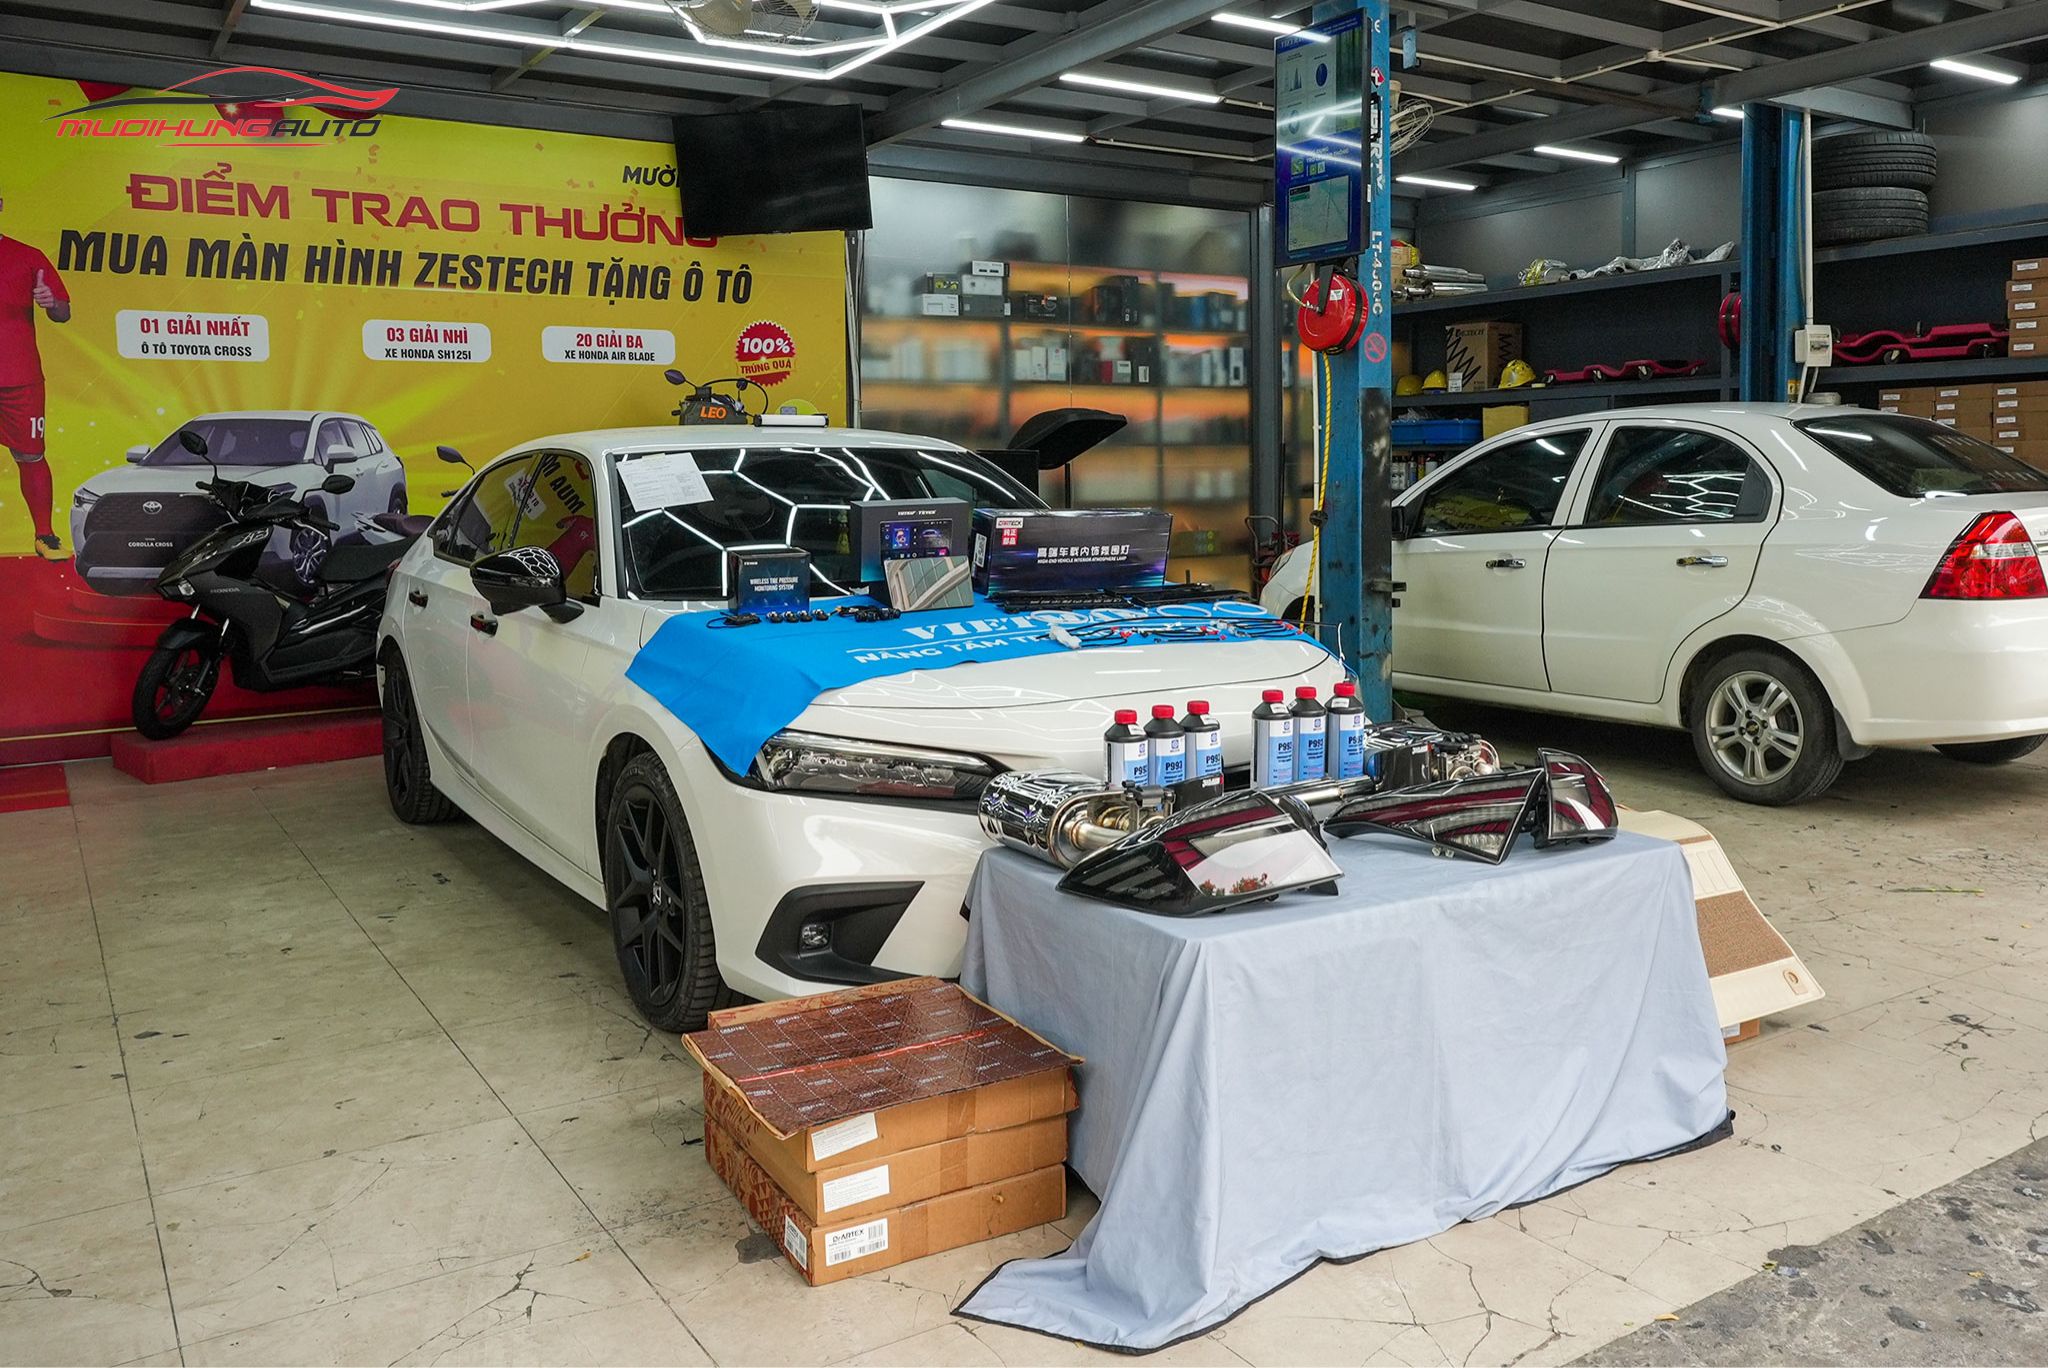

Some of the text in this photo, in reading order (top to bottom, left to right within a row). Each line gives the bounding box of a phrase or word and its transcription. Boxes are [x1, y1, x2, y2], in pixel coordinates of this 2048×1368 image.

[126, 162, 291, 221] ĐIỂM
[311, 187, 481, 233] TRAO
[57, 229, 753, 306] MUA MÀN HÌNH ZESTECH TẶNG Ô TÔ
[140, 313, 250, 337] 01 GIẢI NHẤT
[386, 323, 468, 344] 03 GIẢI NHÌ
[576, 329, 643, 349] 20 GIẢI BA
[742, 337, 791, 354] 100%
[141, 341, 252, 357] Ô TÔ TOYOTA CROSS
[385, 348, 398, 358] XE
[401, 348, 435, 359] HONDA
[564, 350, 656, 362] XE HONDA AIR BLADE
[740, 362, 770, 374] TRÚNG
[700, 405, 728, 419] LEO
[30, 416, 45, 438] 19
